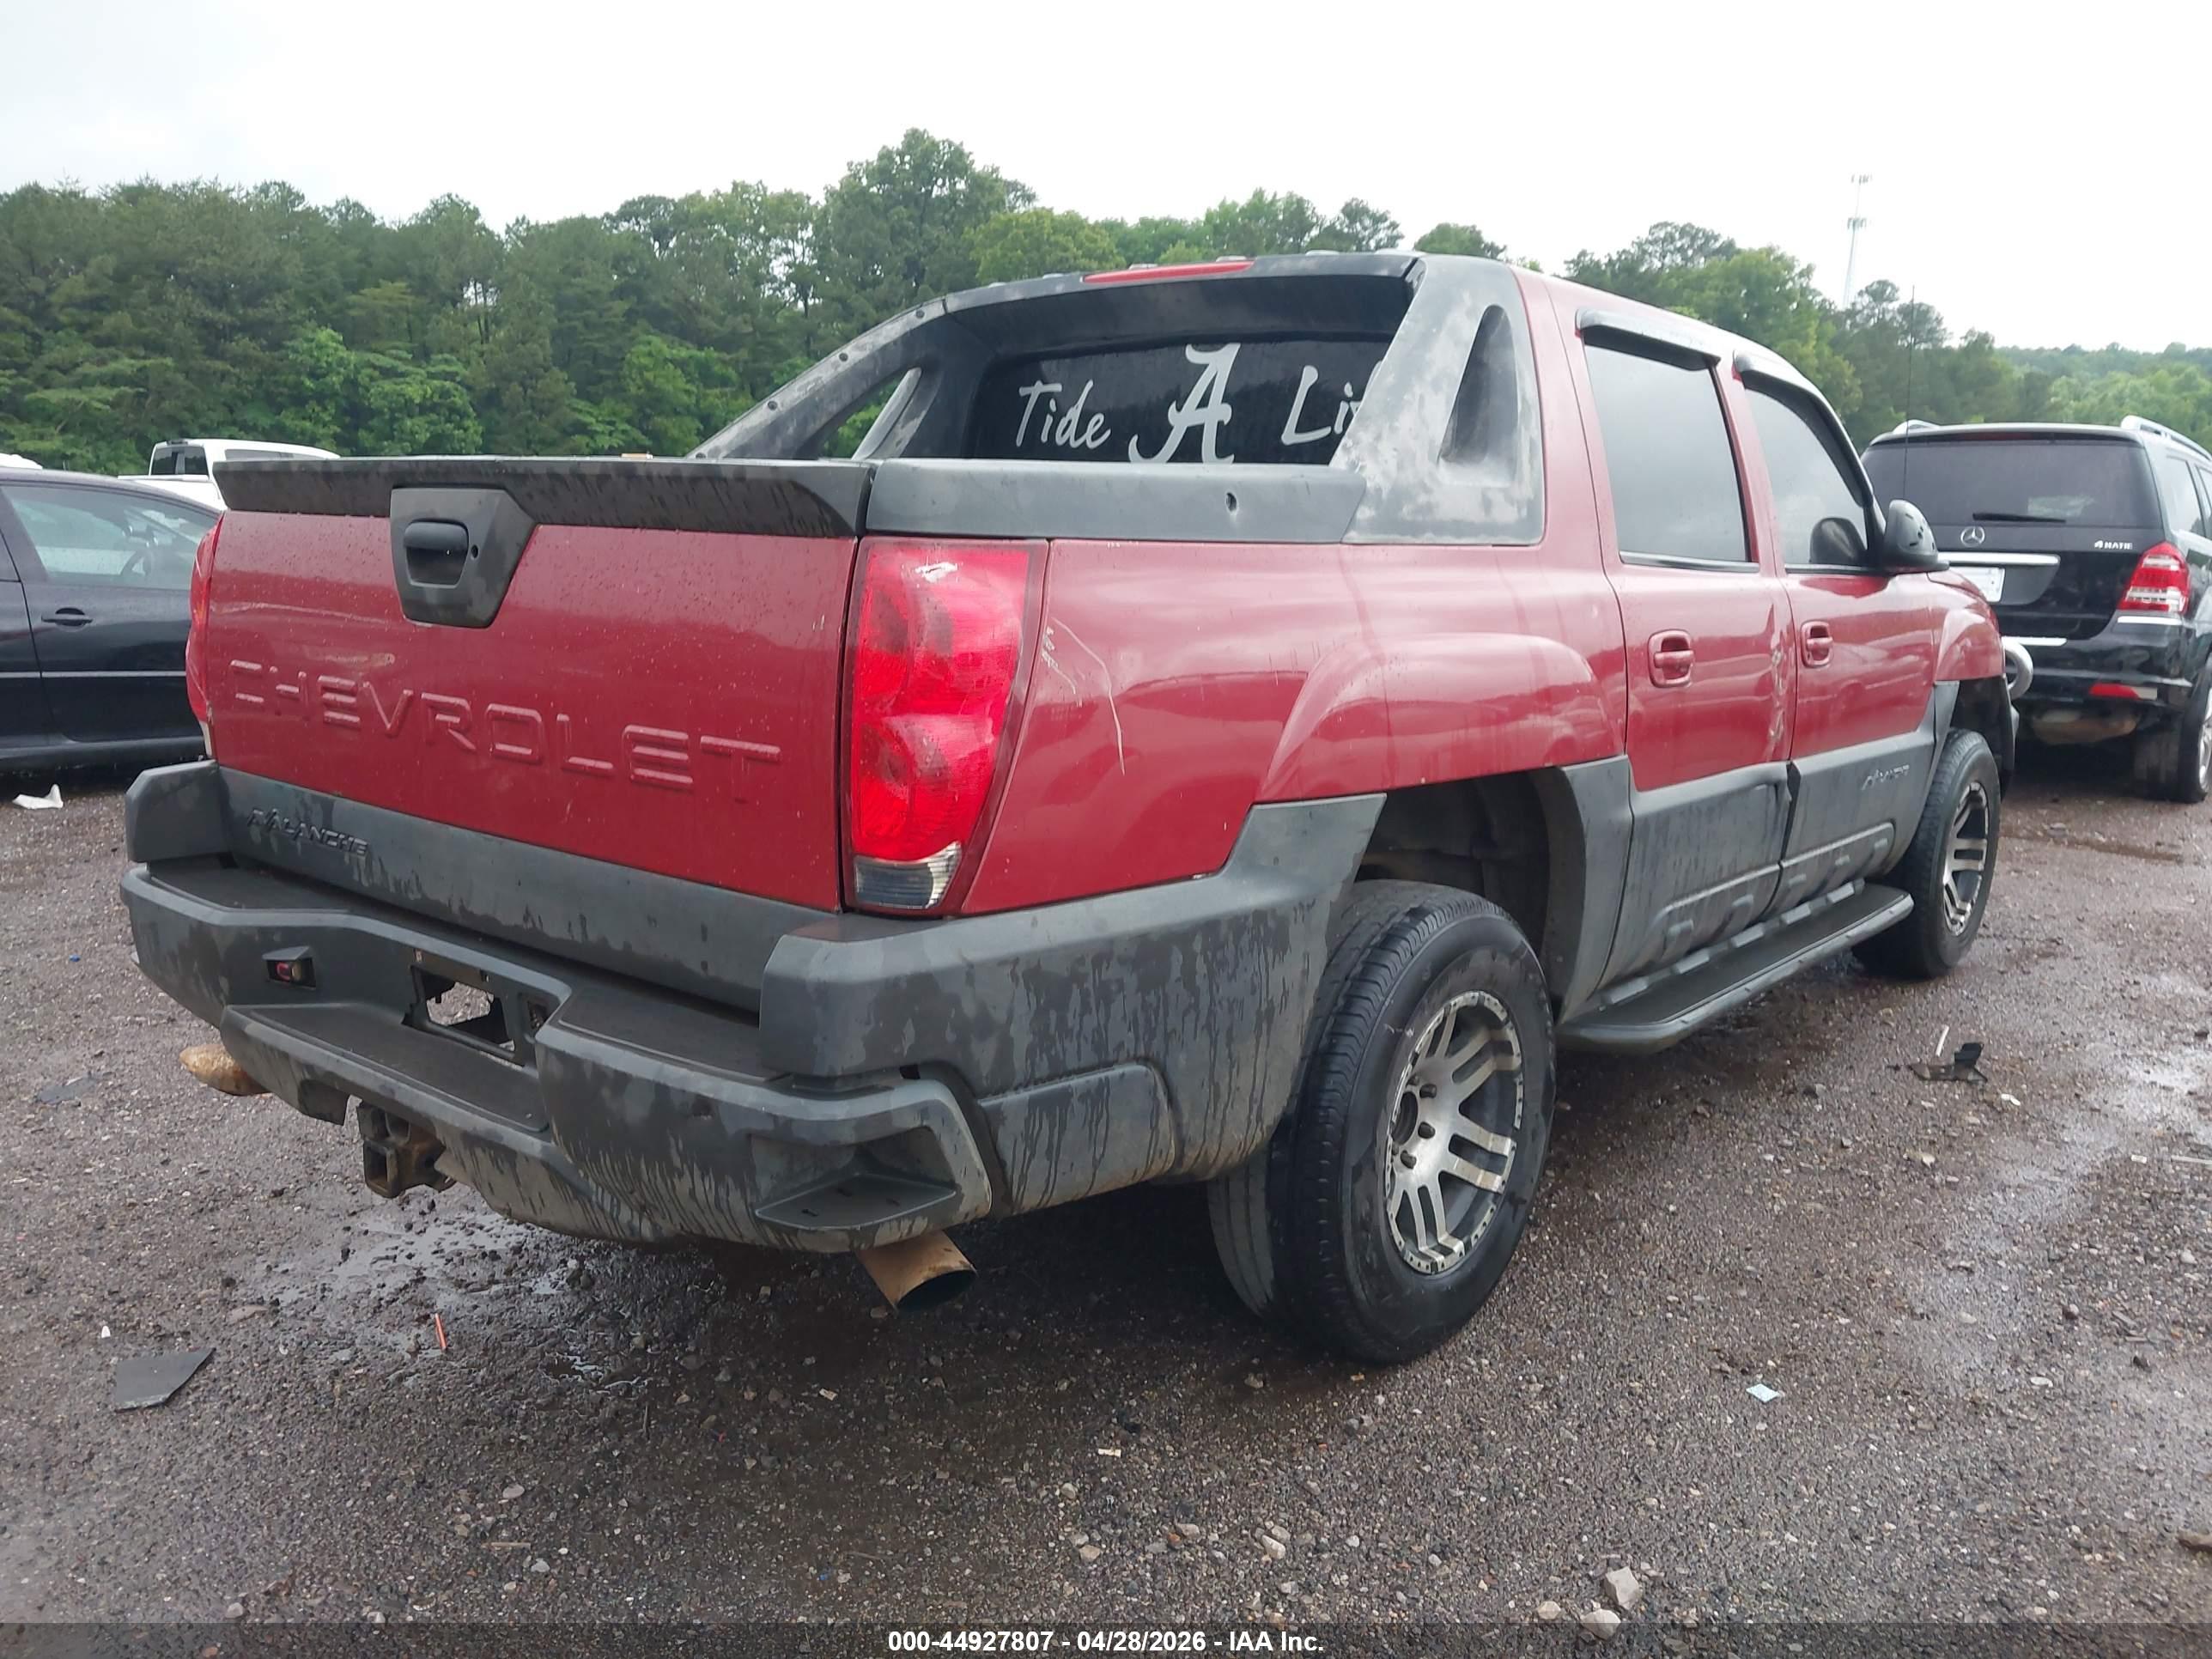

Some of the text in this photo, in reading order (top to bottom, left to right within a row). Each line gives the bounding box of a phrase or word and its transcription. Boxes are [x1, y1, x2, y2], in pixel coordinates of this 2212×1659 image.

[1016, 379, 1111, 449] Tide
[1127, 342, 1243, 464] A
[228, 658, 782, 805] CHEVROLET
[246, 807, 369, 855] AVALANCHE
